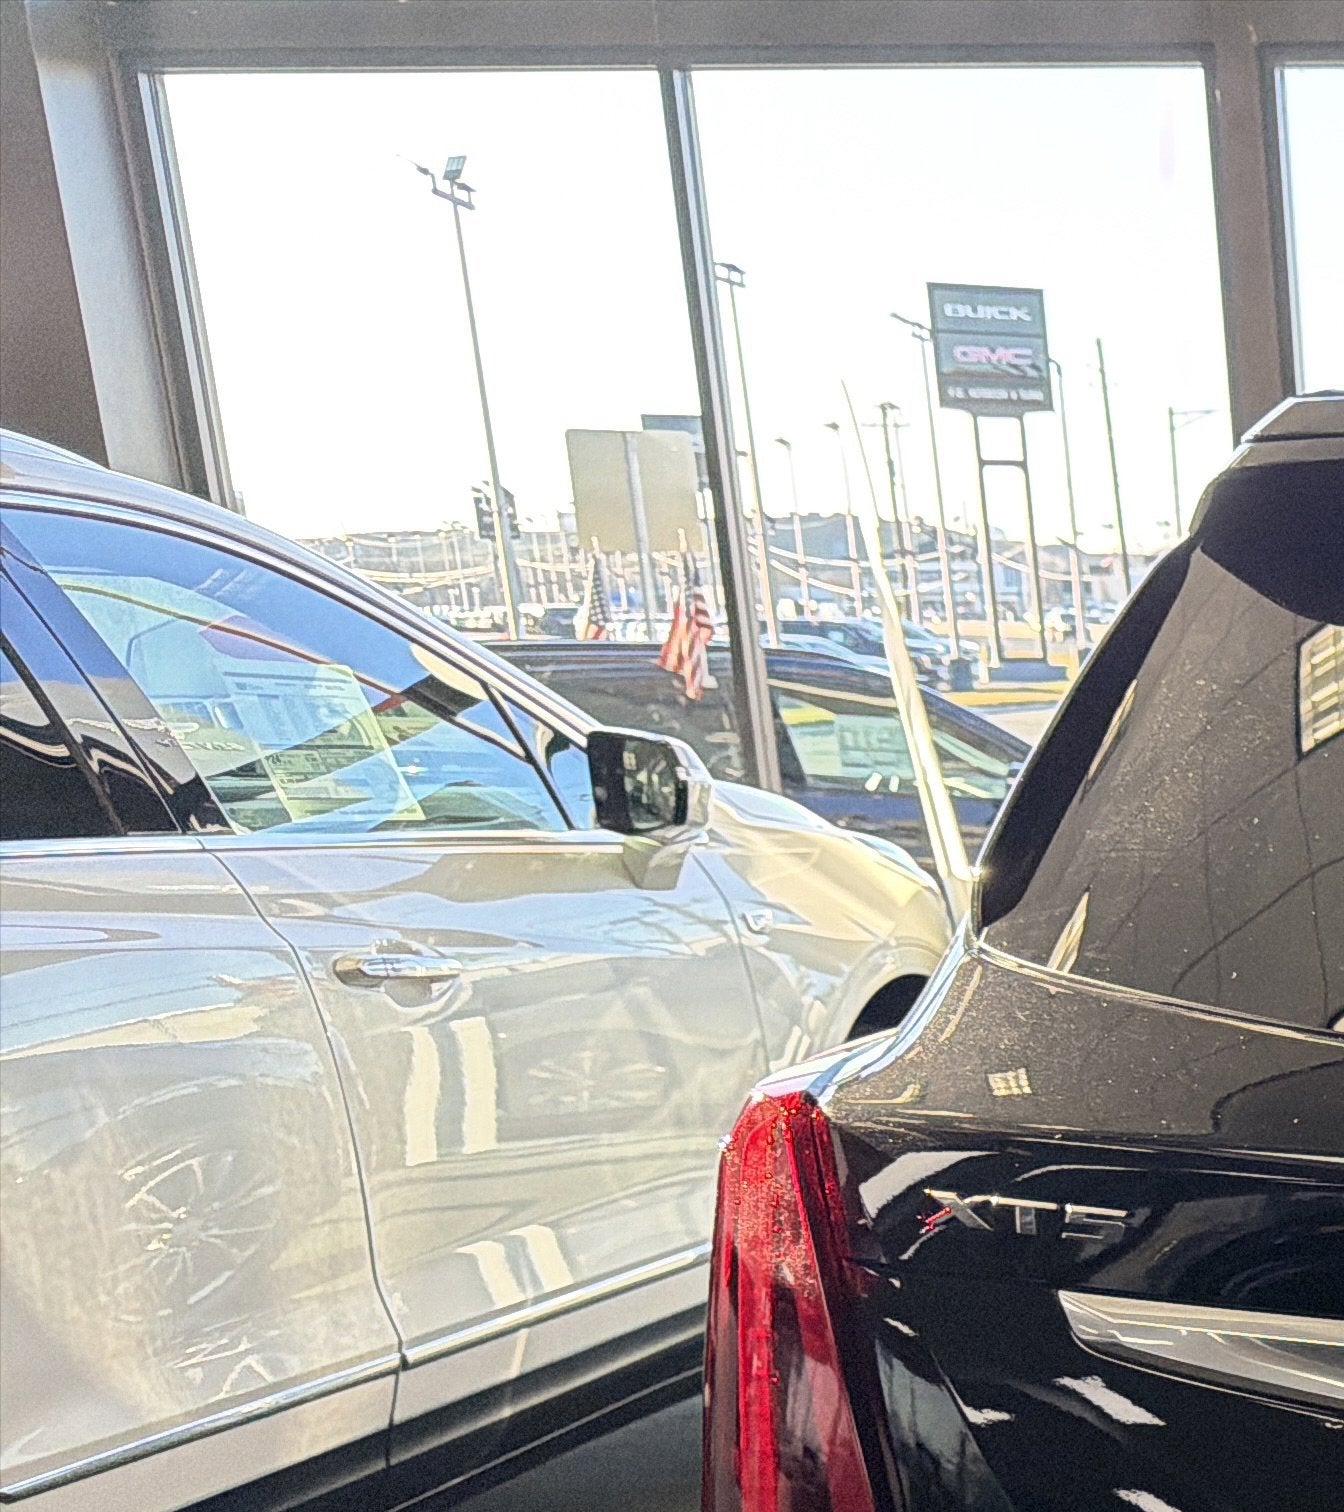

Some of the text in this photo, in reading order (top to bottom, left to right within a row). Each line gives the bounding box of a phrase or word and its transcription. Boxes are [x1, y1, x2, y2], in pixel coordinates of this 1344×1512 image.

[944, 303, 1032, 322] BUICK
[953, 345, 1033, 365] GMC
[918, 1188, 1129, 1240] XT5
